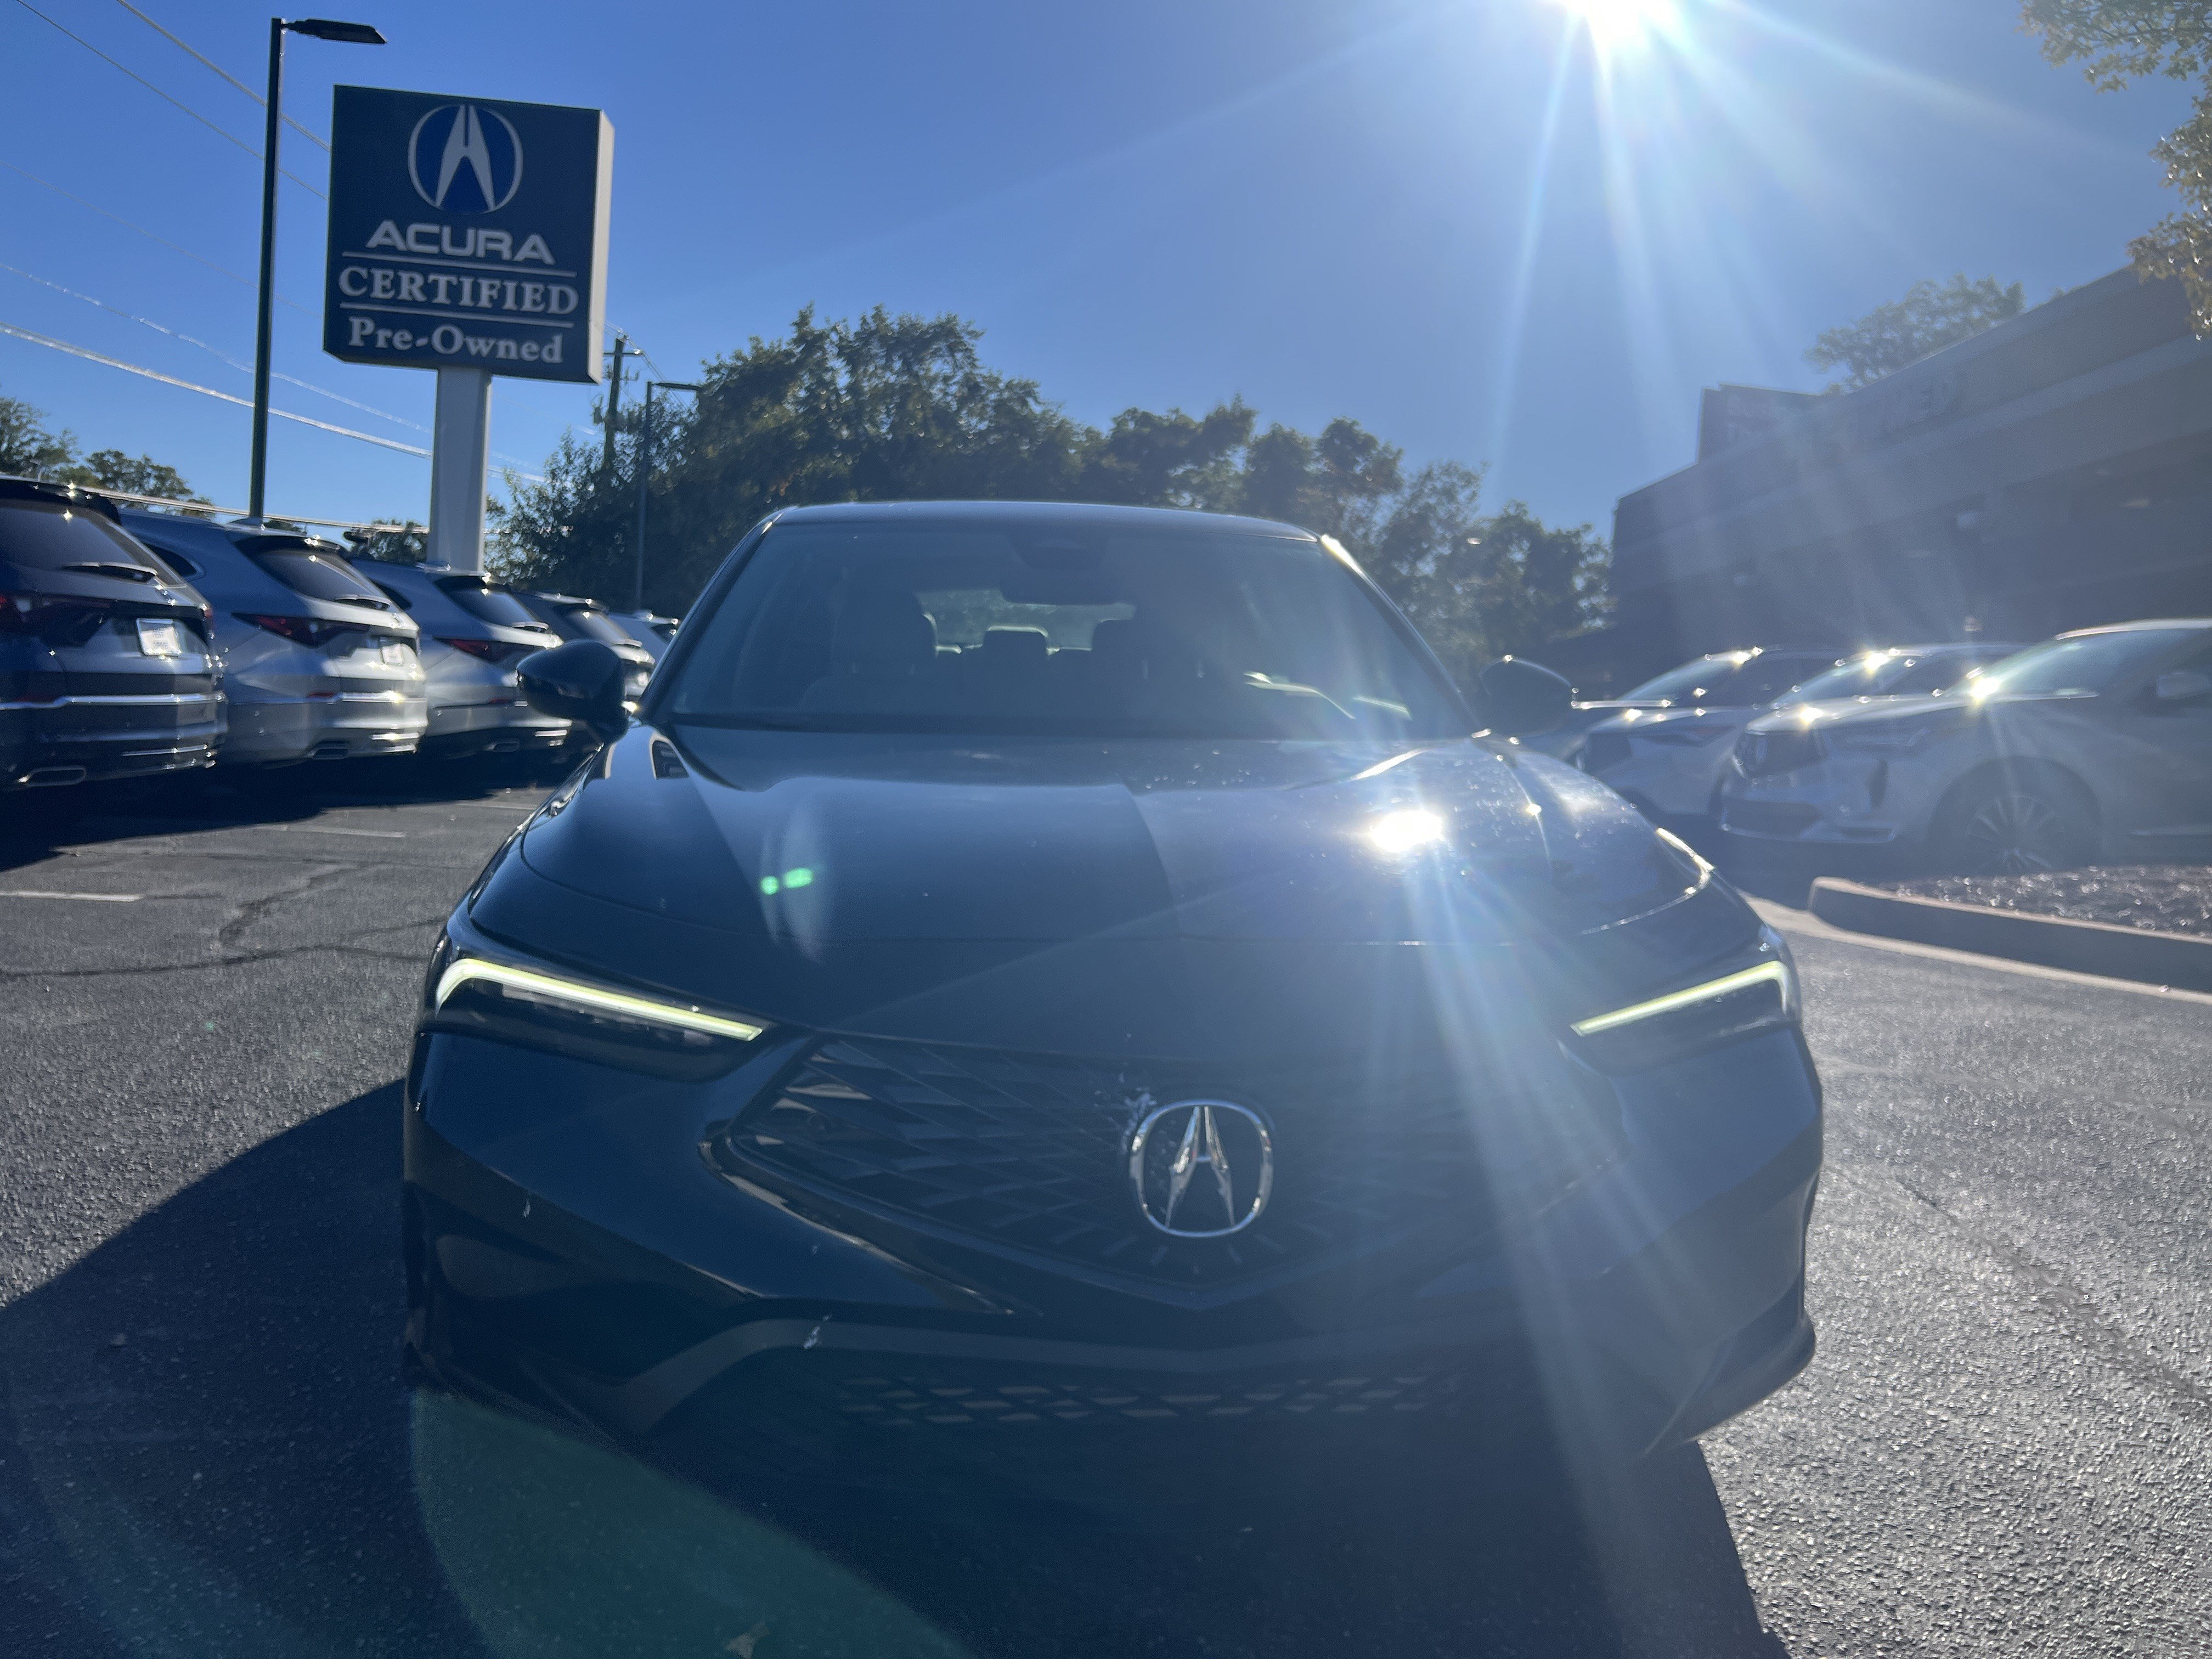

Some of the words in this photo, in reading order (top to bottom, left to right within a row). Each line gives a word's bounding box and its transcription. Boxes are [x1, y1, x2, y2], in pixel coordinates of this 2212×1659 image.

[366, 220, 555, 264] ACURA
[339, 266, 579, 314] CERTIFIED
[348, 317, 562, 363] Pre-Owned
